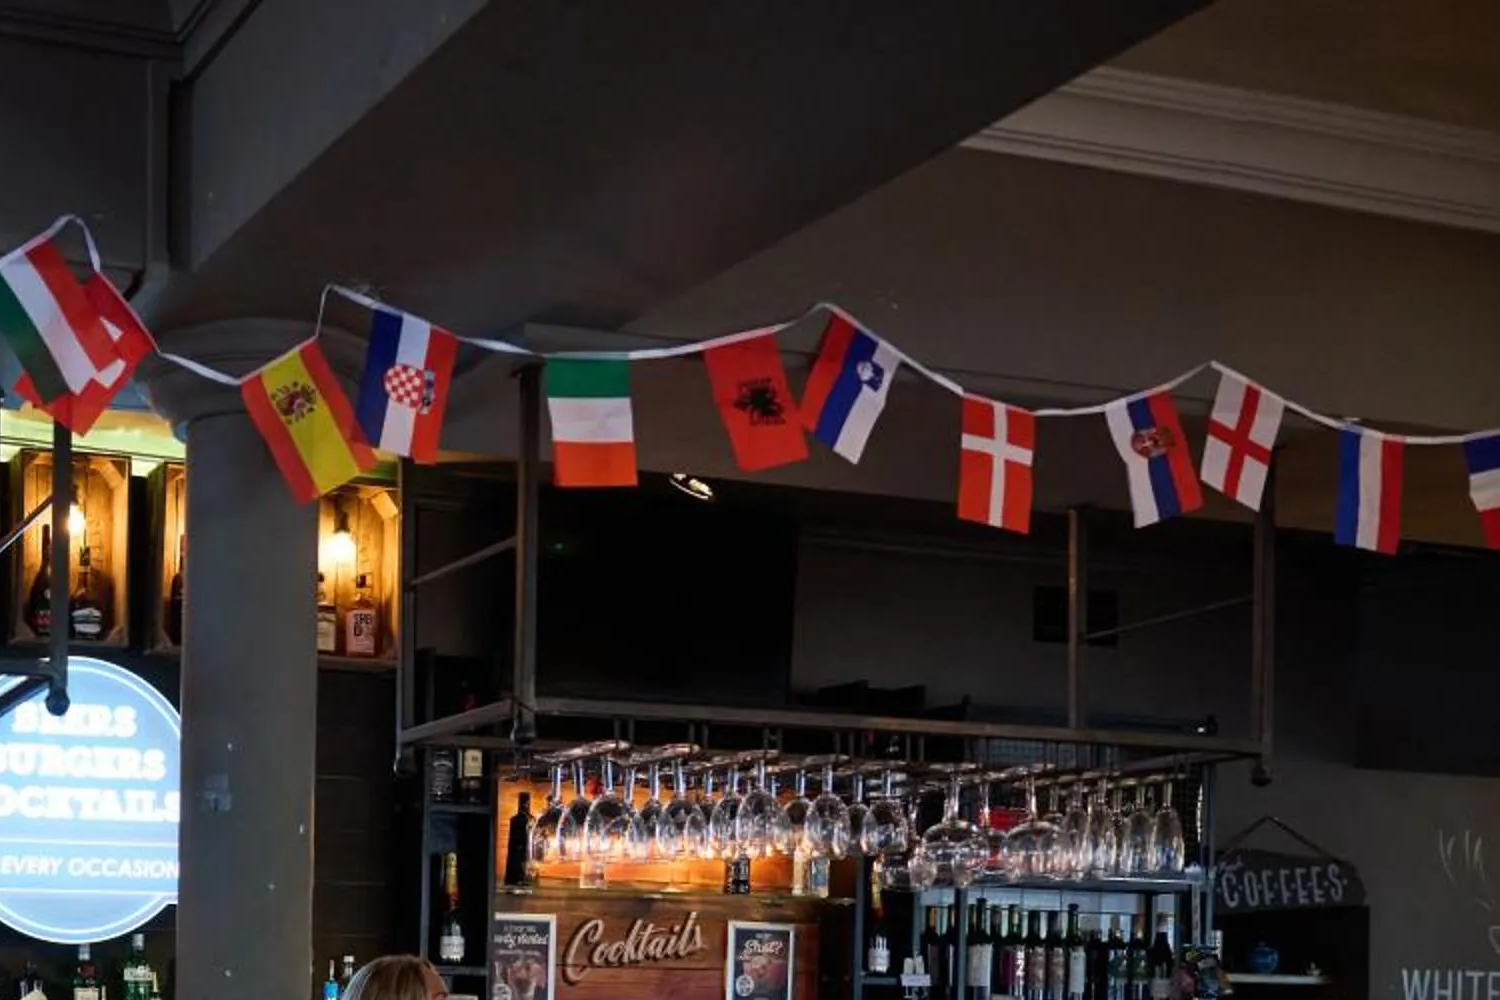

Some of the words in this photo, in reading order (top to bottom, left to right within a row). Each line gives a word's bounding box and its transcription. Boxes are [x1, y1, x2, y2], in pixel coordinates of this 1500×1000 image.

[12, 702, 137, 738] BEERS
[1, 857, 63, 877] EVERY
[68, 857, 180, 878] OCCASION
[1221, 863, 1346, 908] COFFEES
[566, 911, 709, 981] Cocktails
